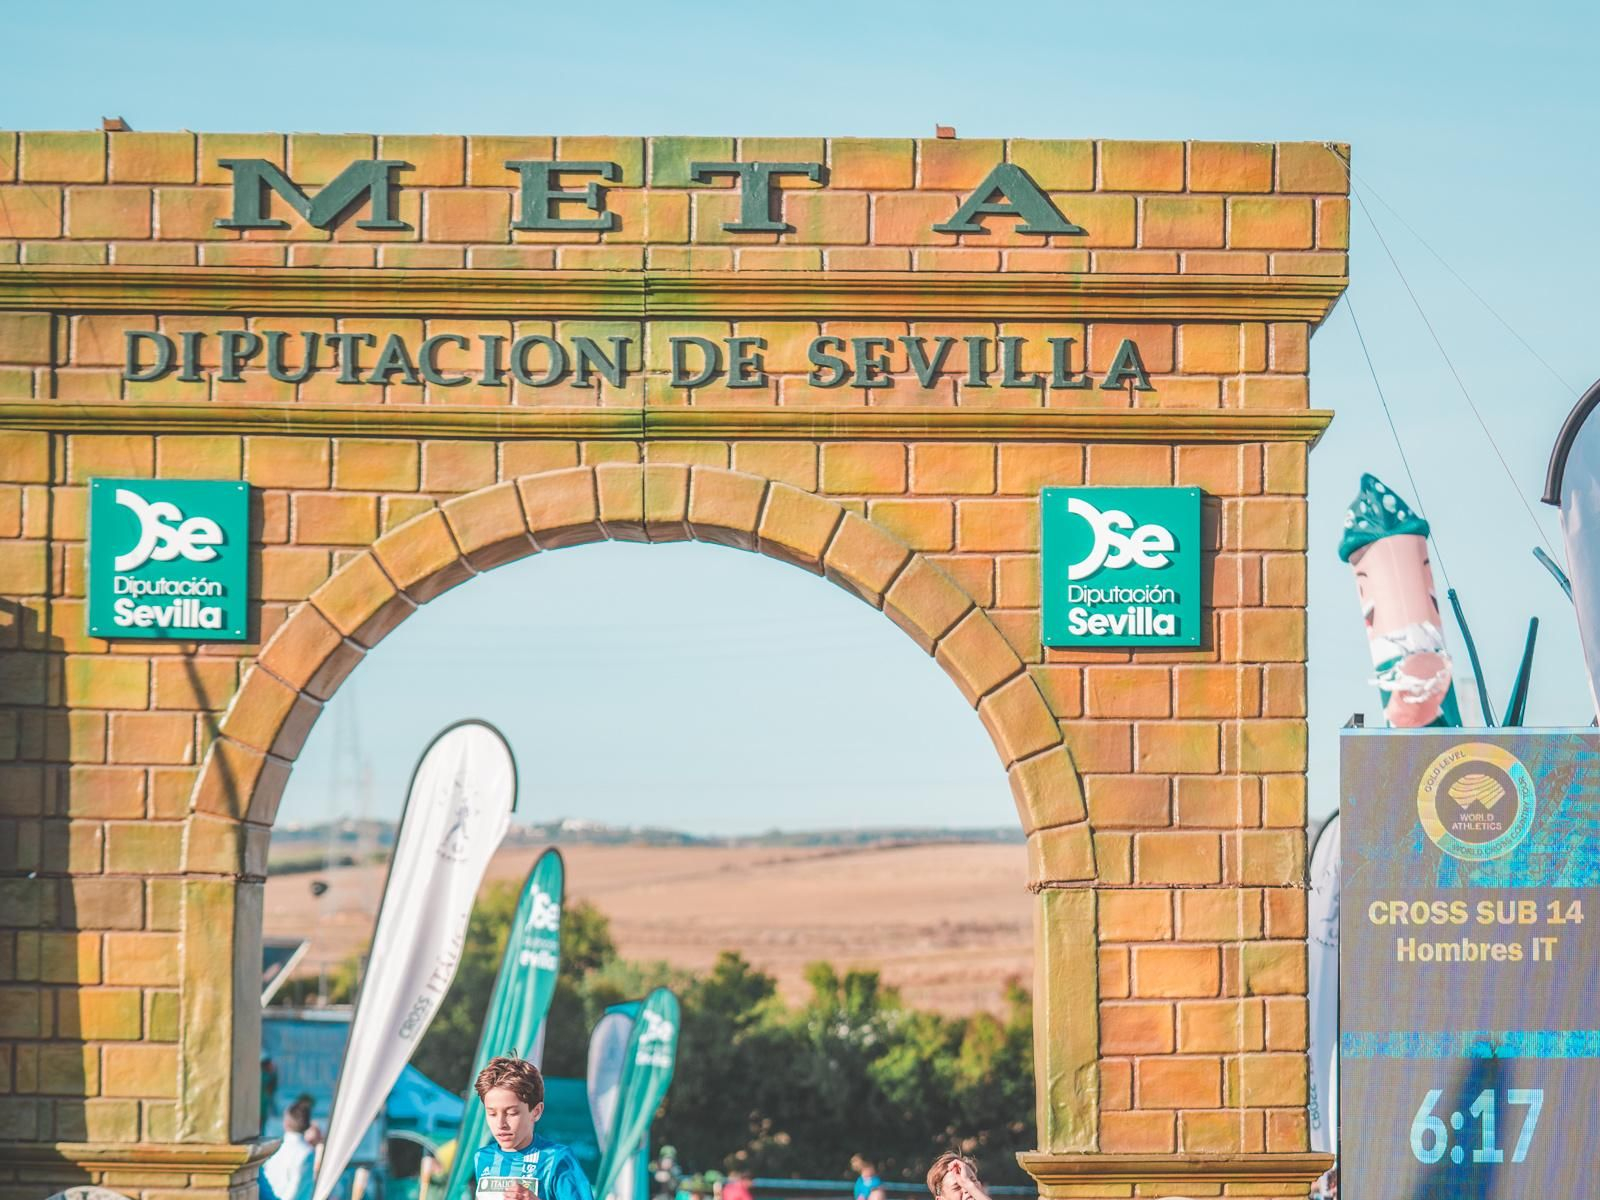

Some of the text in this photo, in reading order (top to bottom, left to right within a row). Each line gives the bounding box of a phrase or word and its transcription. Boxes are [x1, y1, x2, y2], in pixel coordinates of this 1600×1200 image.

[214, 159, 1085, 235] META
[123, 329, 1155, 391] DIPUTACION DE SEVILLA
[114, 576, 222, 598] Diputación
[1068, 584, 1175, 607] Diputación
[113, 597, 222, 629] Sevilla
[1068, 606, 1175, 636] Sevilla
[1425, 750, 1466, 793] GOLD LEVEL
[1452, 822, 1502, 830] ATHLETICS
[1460, 813, 1494, 821] WORLD
[1368, 900, 1584, 924] CROSS SUB 14
[1396, 937, 1558, 962] Hombres IT
[399, 996, 430, 1040] CROSS
[1409, 1088, 1544, 1164] 6:17
